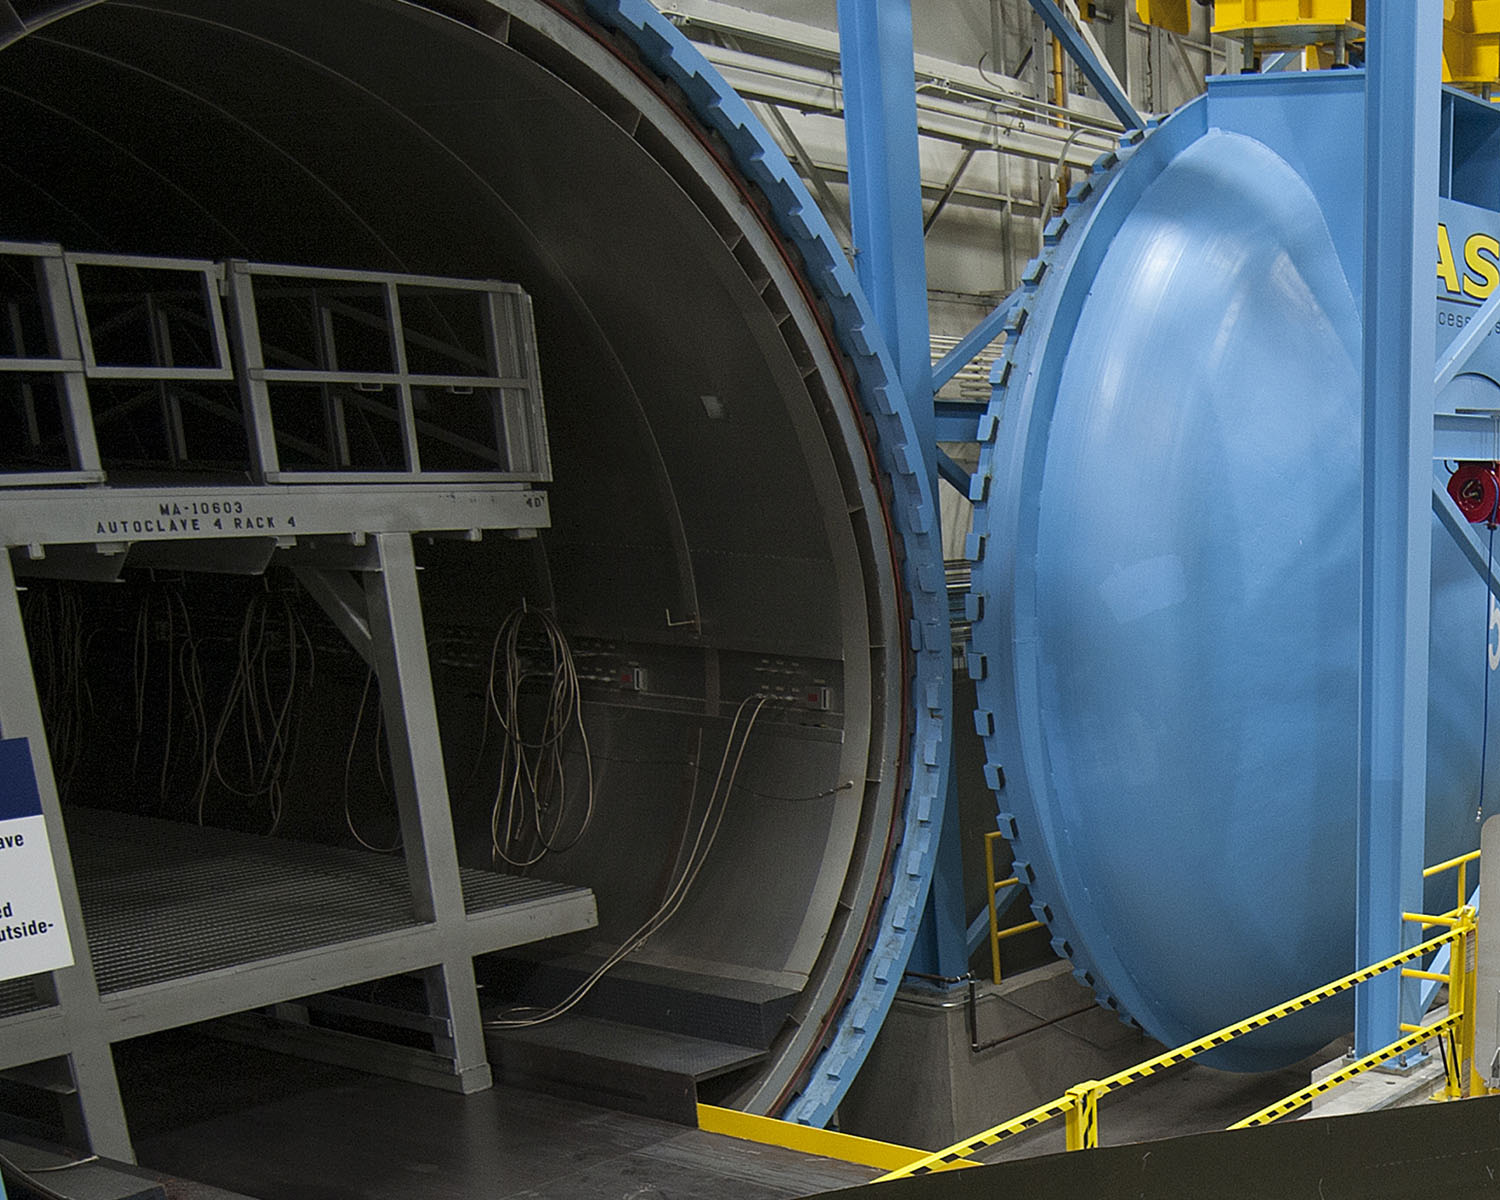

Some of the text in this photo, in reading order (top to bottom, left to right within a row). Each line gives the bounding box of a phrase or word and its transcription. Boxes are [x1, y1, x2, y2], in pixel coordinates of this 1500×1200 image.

[159, 502, 243, 515] MA-10603
[96, 516, 296, 533] AUTOCLAVE 4 RACK 4
